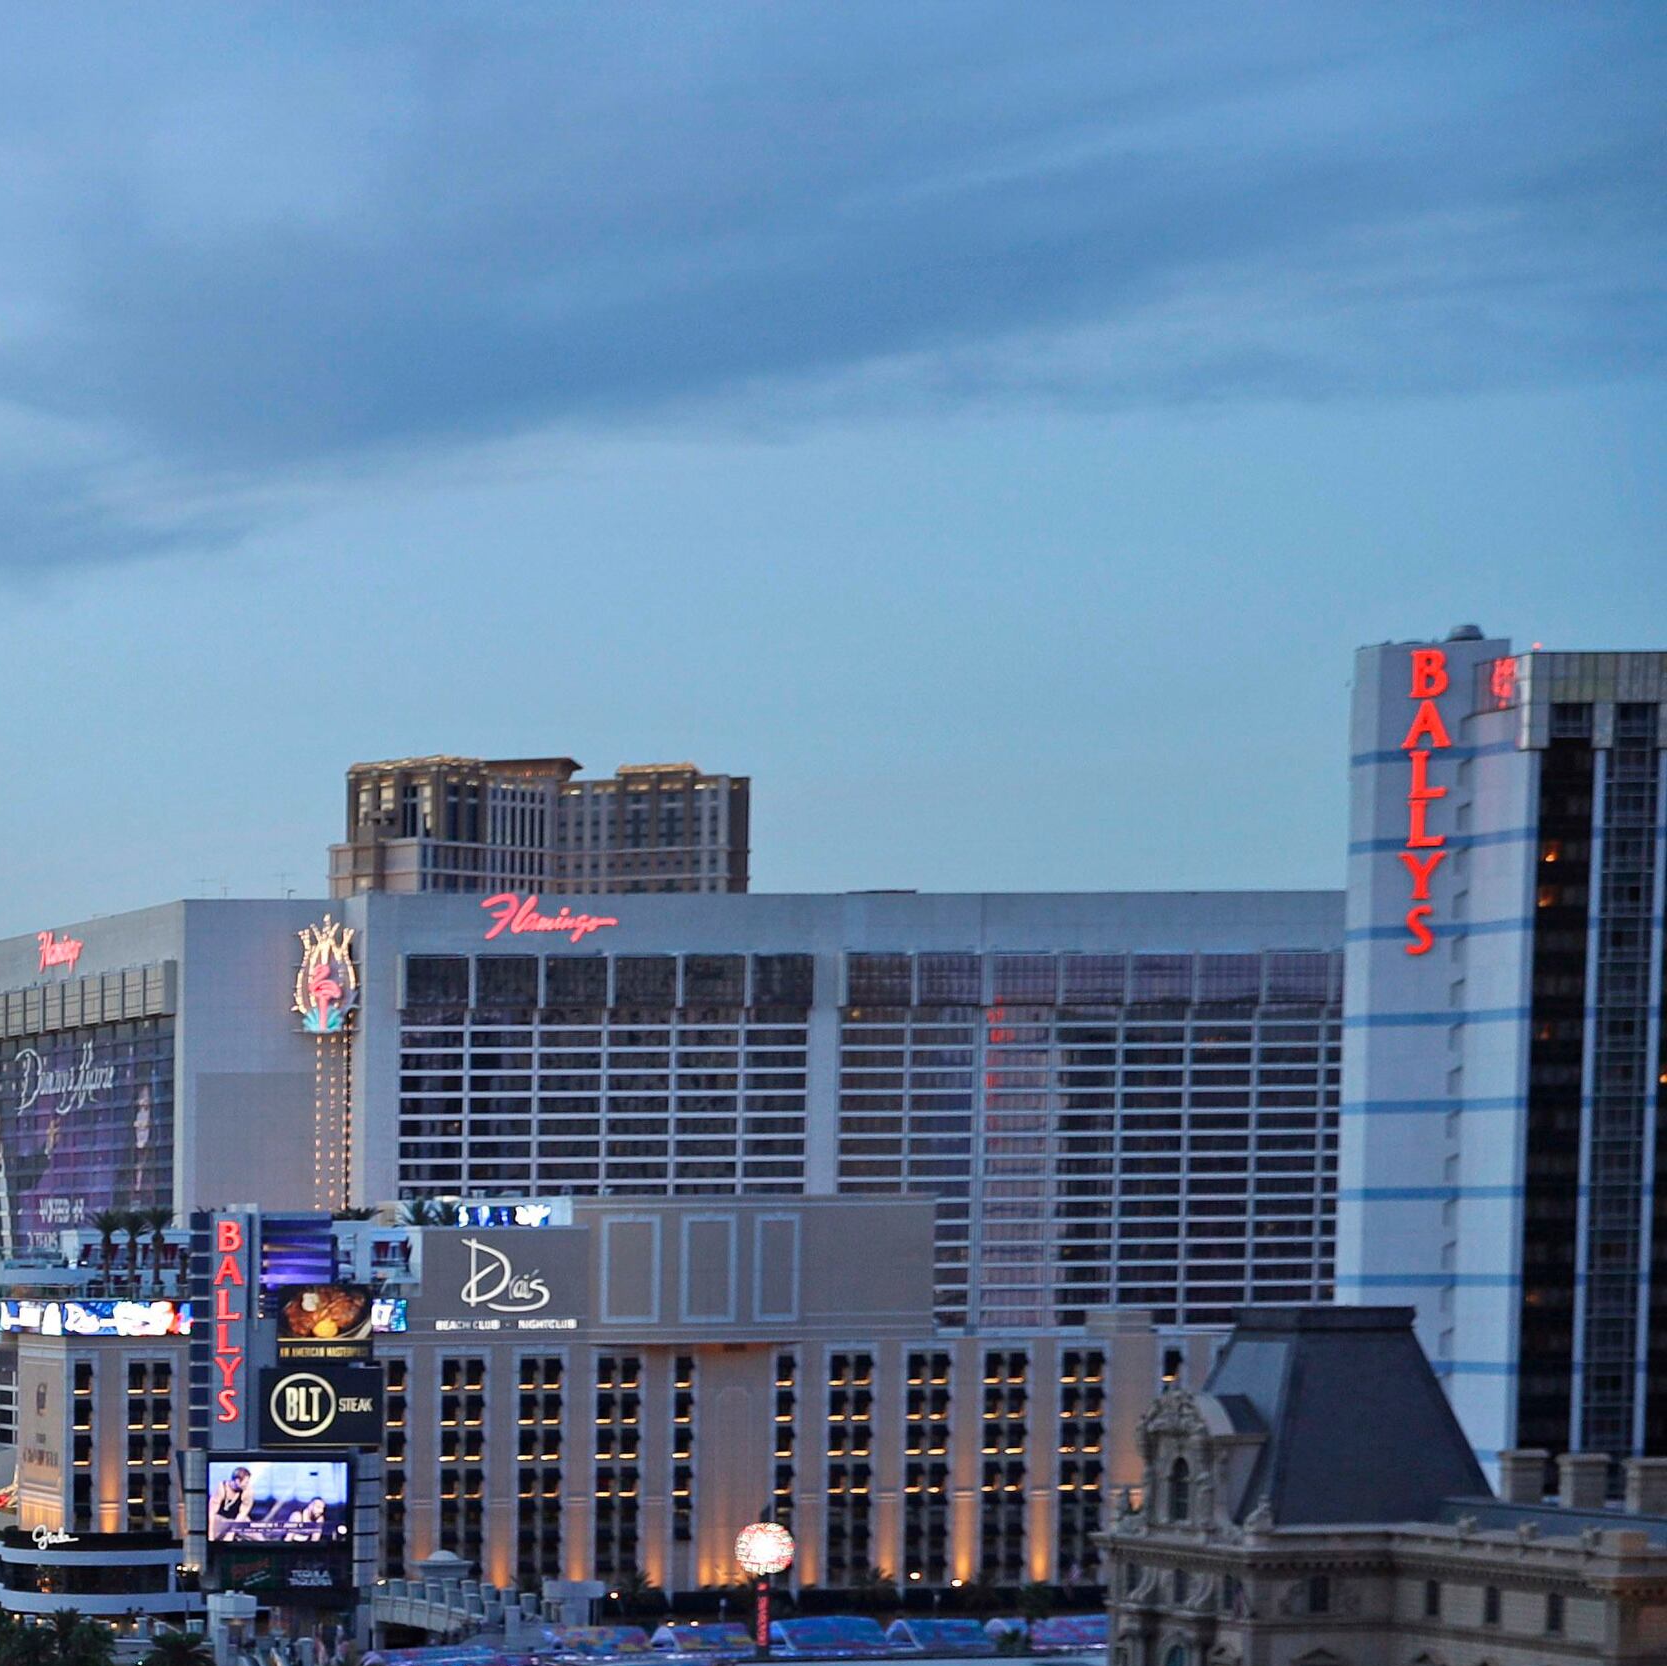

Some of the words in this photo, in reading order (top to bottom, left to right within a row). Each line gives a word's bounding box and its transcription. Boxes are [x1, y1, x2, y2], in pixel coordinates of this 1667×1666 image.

[1398, 649, 1452, 956] BALLYS
[480, 892, 618, 943] Flamingo
[461, 1238, 550, 1312] Drai's
[213, 1220, 245, 1422] BALLYS
[472, 1319, 501, 1331] CLUB
[517, 1318, 578, 1330] NIGHTCLUB
[284, 1387, 322, 1422] BLT
[338, 1398, 372, 1412] STEAK
